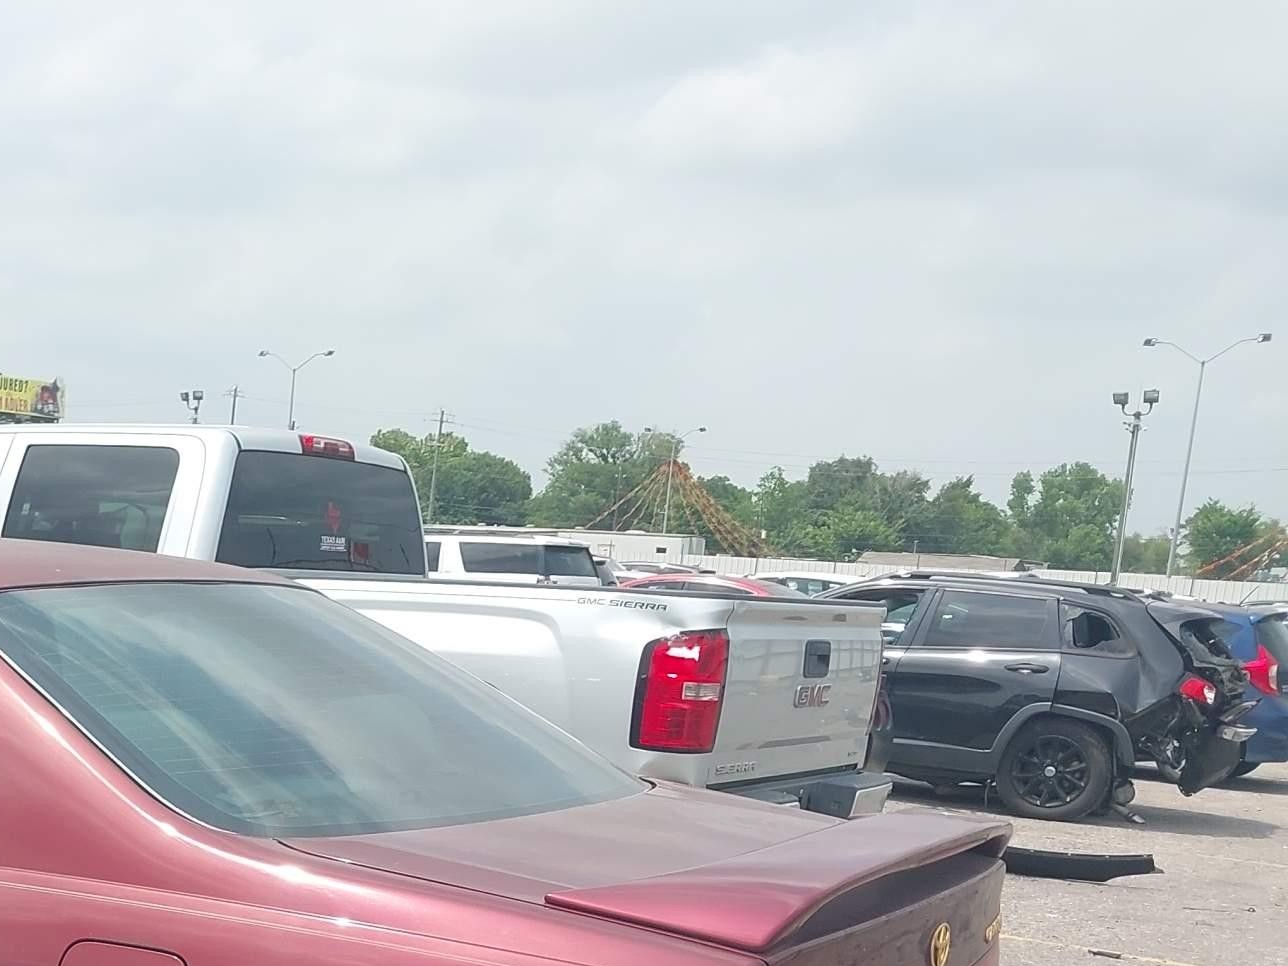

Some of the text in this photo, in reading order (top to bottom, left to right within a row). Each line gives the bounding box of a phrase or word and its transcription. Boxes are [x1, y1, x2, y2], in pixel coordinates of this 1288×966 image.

[577, 597, 669, 611] GMC SIERRA
[793, 684, 832, 708] GMC
